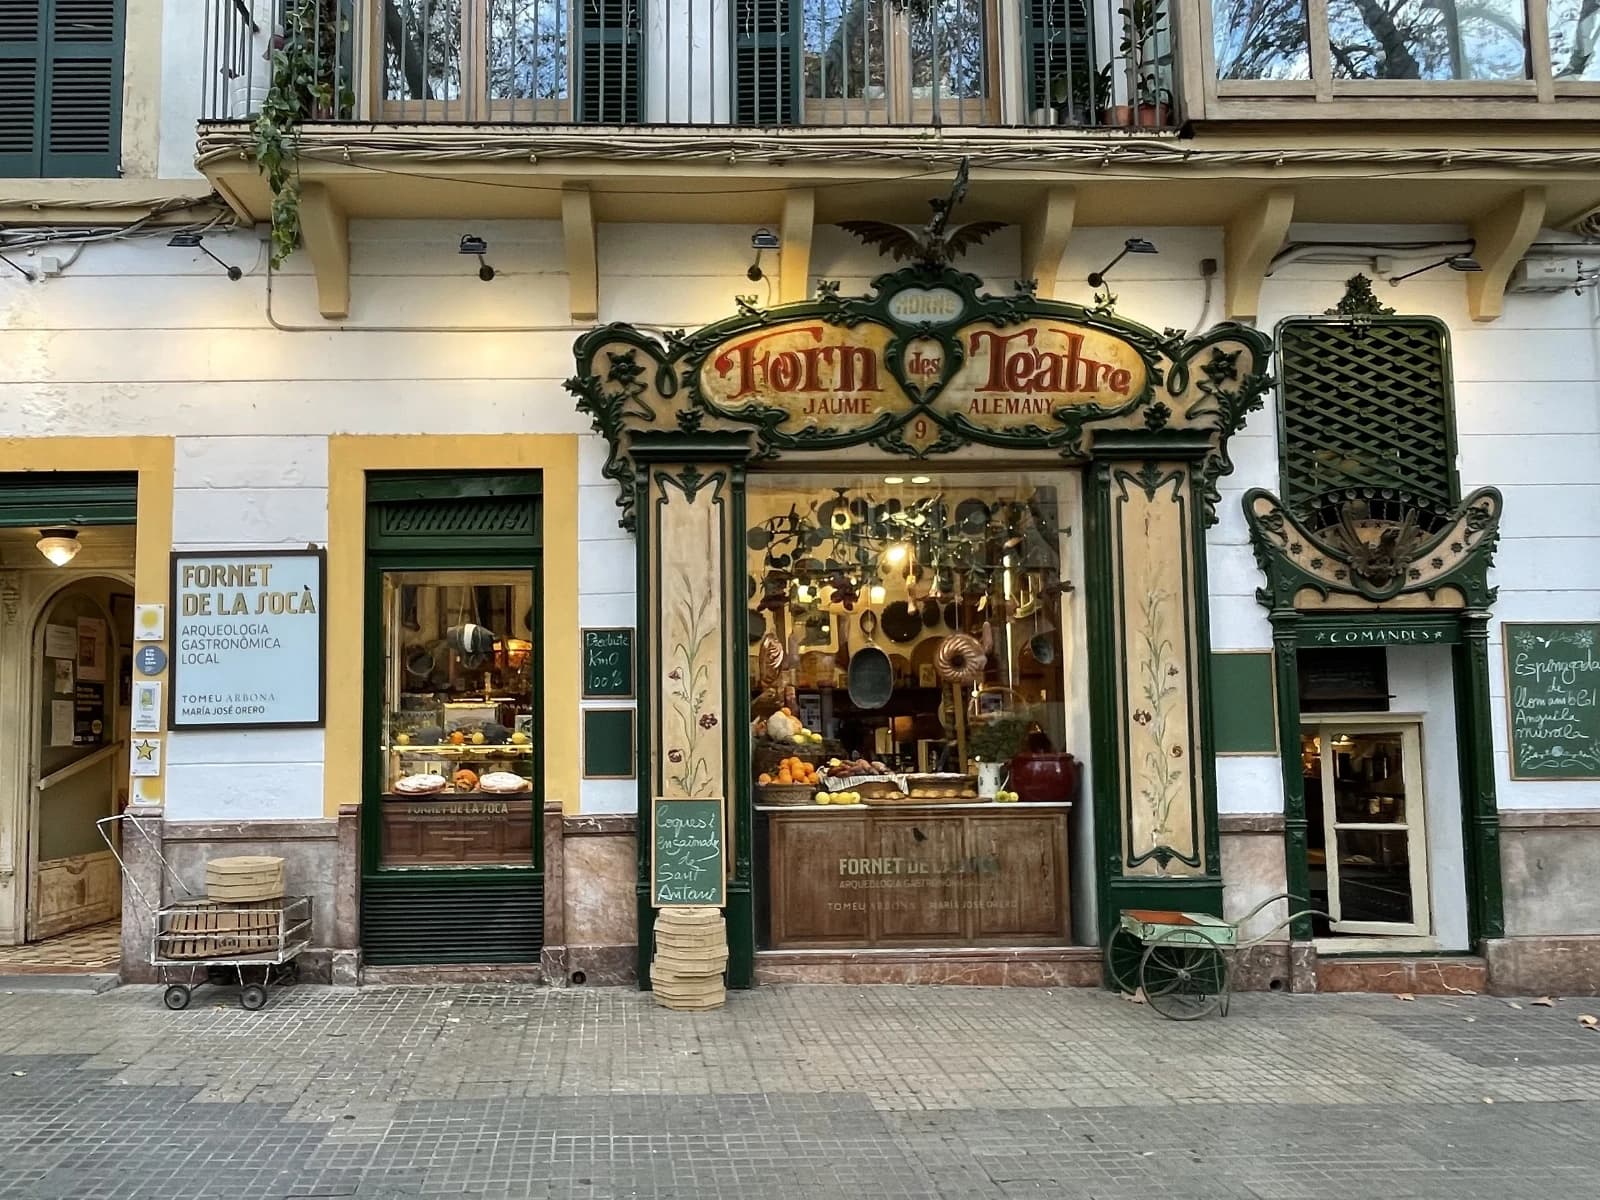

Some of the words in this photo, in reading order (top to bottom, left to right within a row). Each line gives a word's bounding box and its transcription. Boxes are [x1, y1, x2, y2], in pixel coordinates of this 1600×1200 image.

[714, 326, 885, 400] Forn
[908, 350, 941, 377] des
[969, 327, 1132, 397] Teatre
[803, 398, 872, 415] JAUME
[968, 398, 1055, 415] ALEMANY
[914, 421, 927, 440] 9
[182, 564, 273, 588] FORNET
[182, 593, 212, 616] DE
[217, 592, 249, 615] LA
[181, 624, 269, 638] ARQUEOLOGIA
[181, 636, 281, 651] GASTRONÒMICA
[181, 653, 220, 665] LOCAL
[1547, 676, 1567, 694] de
[182, 695, 222, 704] TOMEU
[226, 693, 275, 702] ARBONA
[182, 705, 211, 716] MARÍA
[212, 704, 233, 715] JOSÉ
[235, 706, 265, 715] ORERO
[657, 804, 707, 838] Coques
[657, 863, 707, 882] Sant
[839, 857, 905, 876] FORNET
[657, 884, 717, 902] Antoni
[826, 902, 866, 912] TOMEU
